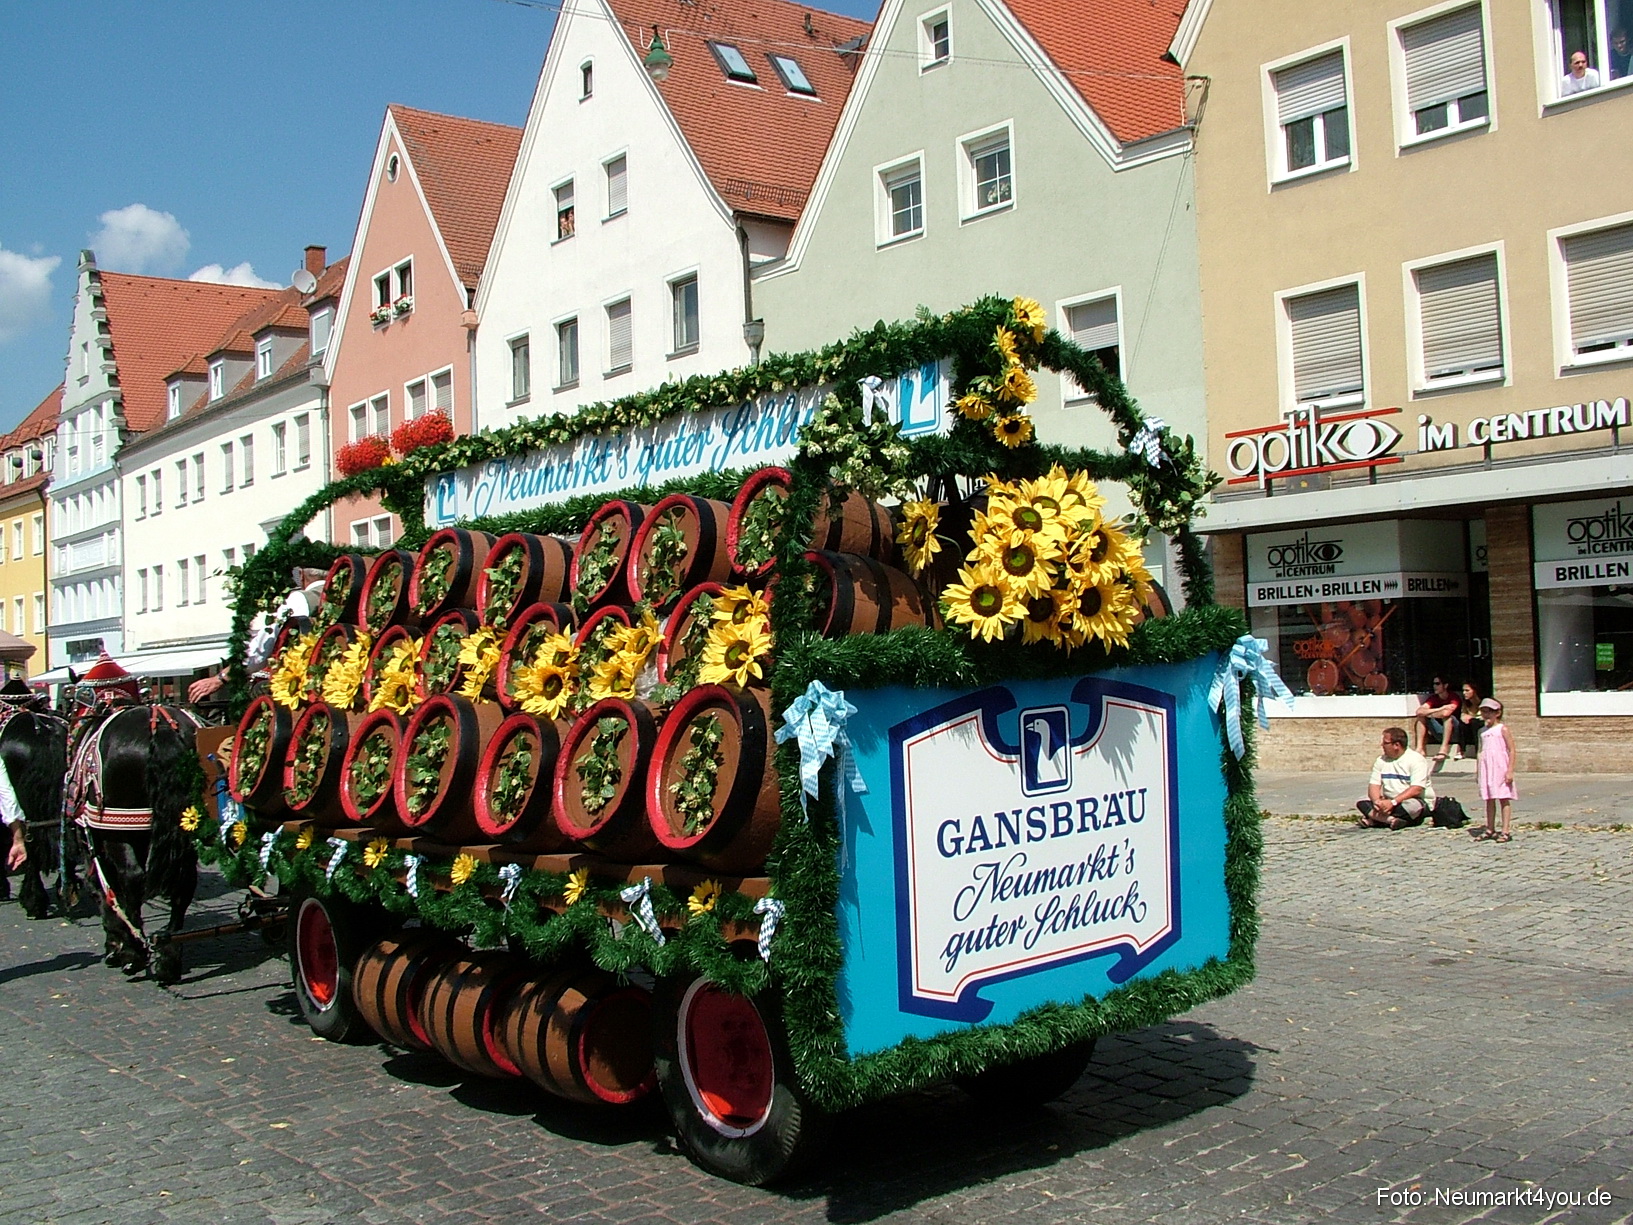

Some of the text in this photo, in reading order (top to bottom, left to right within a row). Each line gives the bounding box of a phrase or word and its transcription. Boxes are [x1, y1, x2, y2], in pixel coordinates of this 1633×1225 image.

[475, 393, 816, 518] Neumarkt's guter Schlu
[1227, 404, 1338, 490] optik
[1468, 397, 1631, 446] CENTRUM
[1267, 531, 1318, 577] optik
[1286, 564, 1335, 578] CENTRUM
[1556, 562, 1630, 582] BRILLEN
[1257, 580, 1382, 601] BRILLEN BRILLEN
[1407, 578, 1451, 592] BRILLEN
[936, 787, 1148, 858] GANSBRÄU
[953, 837, 1135, 922] Neumarkt's
[940, 880, 1148, 974] guter Schluck
